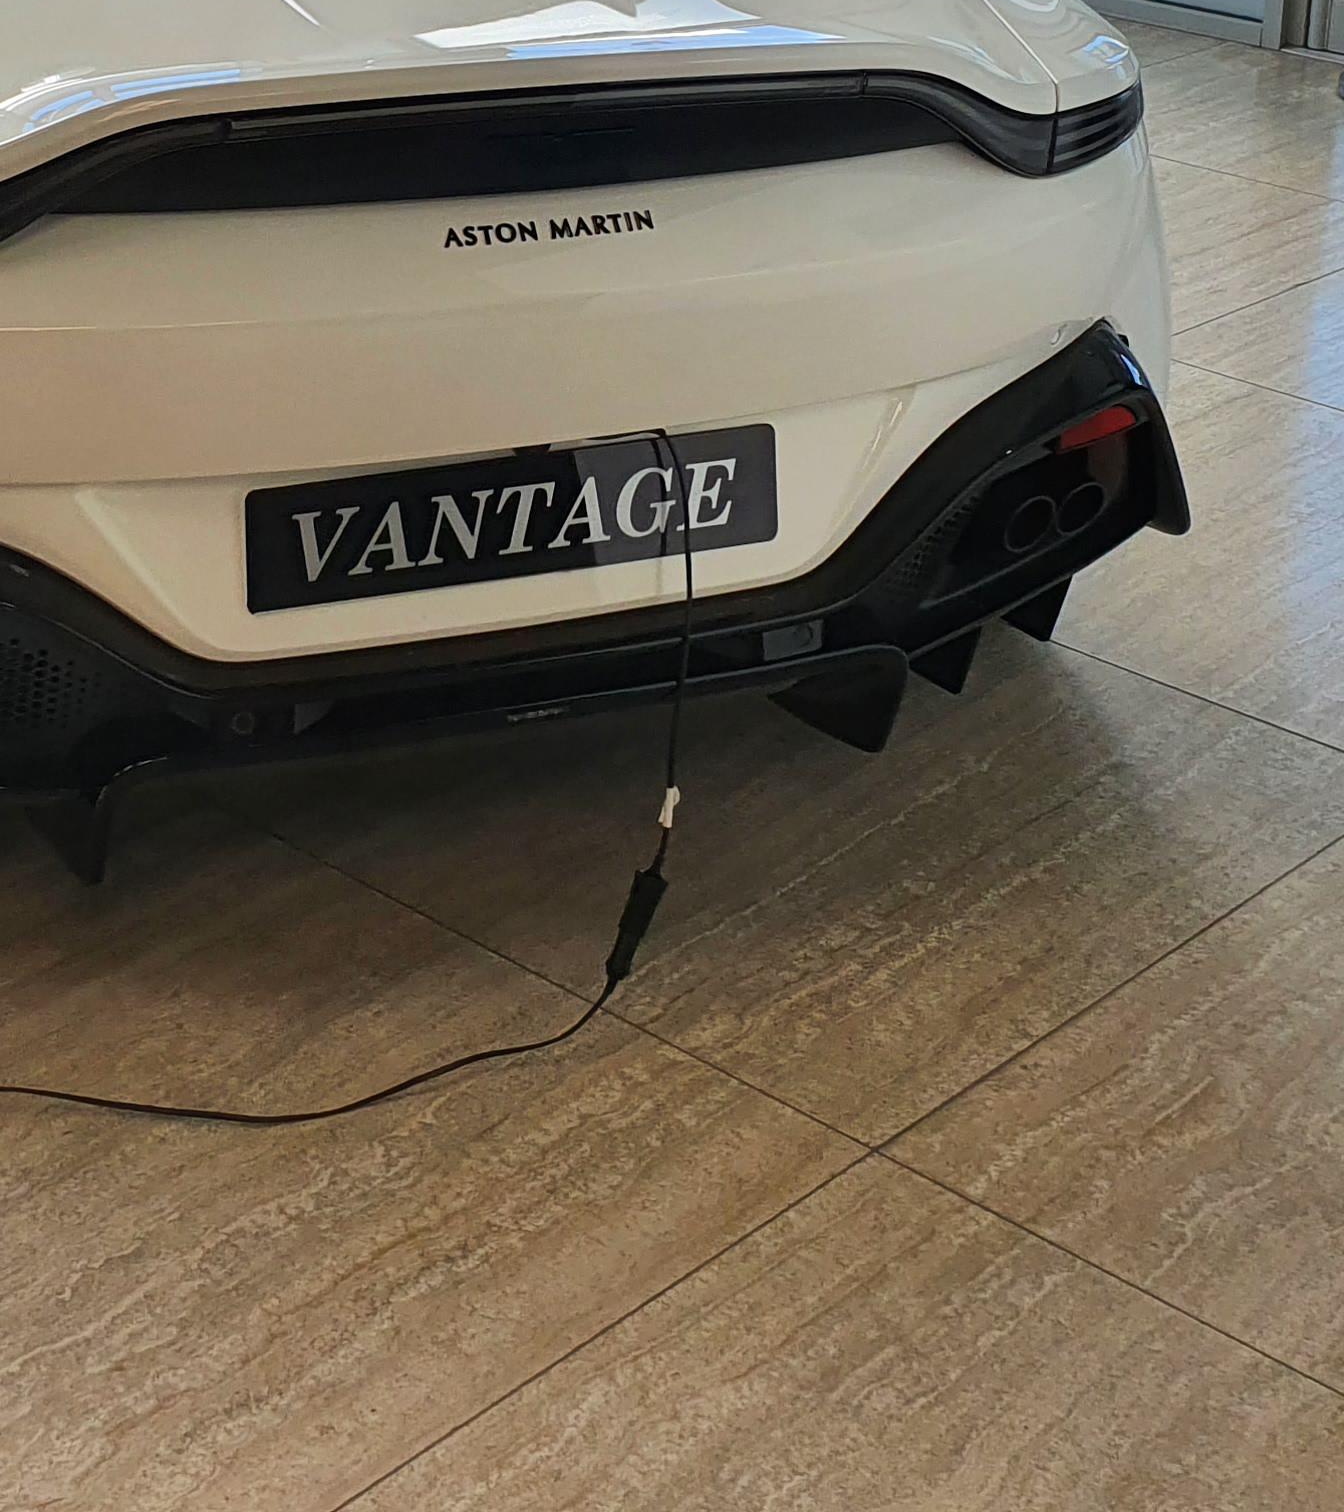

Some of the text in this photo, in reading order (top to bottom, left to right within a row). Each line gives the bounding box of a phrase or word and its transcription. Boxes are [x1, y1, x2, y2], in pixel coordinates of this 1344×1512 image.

[444, 209, 655, 249] ASTON MARTIN
[291, 457, 738, 583] VANTAGE
